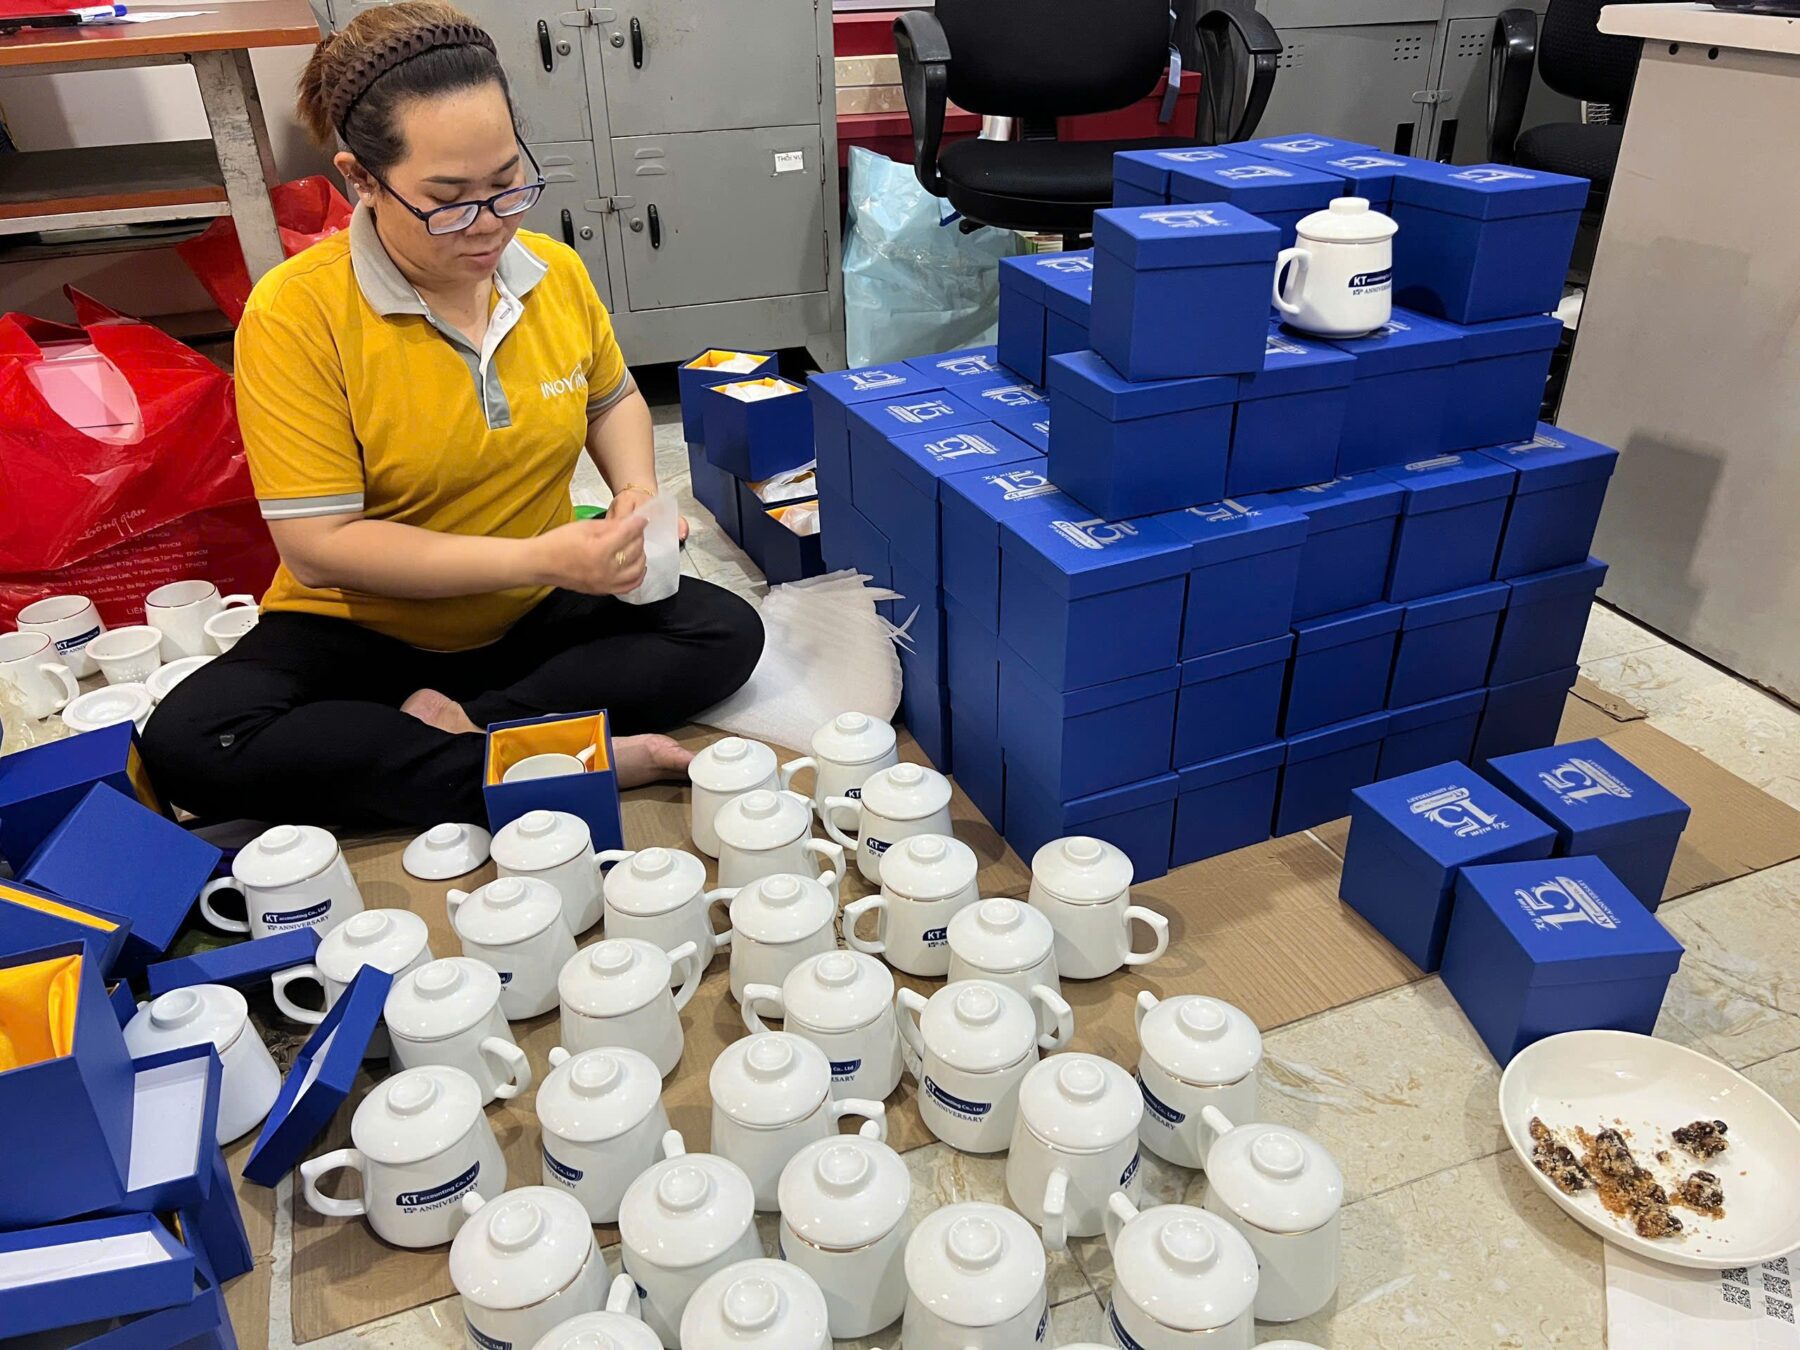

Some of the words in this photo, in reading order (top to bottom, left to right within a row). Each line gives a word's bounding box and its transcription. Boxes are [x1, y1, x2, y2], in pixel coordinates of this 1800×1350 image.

[1353, 275, 1367, 286] KT
[987, 469, 1048, 493] 15
[56, 641, 68, 650] KT
[848, 790, 861, 798] KT
[1538, 761, 1613, 804] 15
[1424, 798, 1498, 837] 15
[869, 839, 879, 849] KT
[1514, 880, 1594, 931] 15
[265, 914, 279, 923] KT
[927, 931, 941, 940] KT
[932, 1099, 984, 1123] ANNIVERSARY
[401, 1195, 418, 1205] KT
[420, 1185, 455, 1201] accounting
[466, 1171, 475, 1181] Ltd
[419, 1181, 478, 1212] ANNIVERSARY
